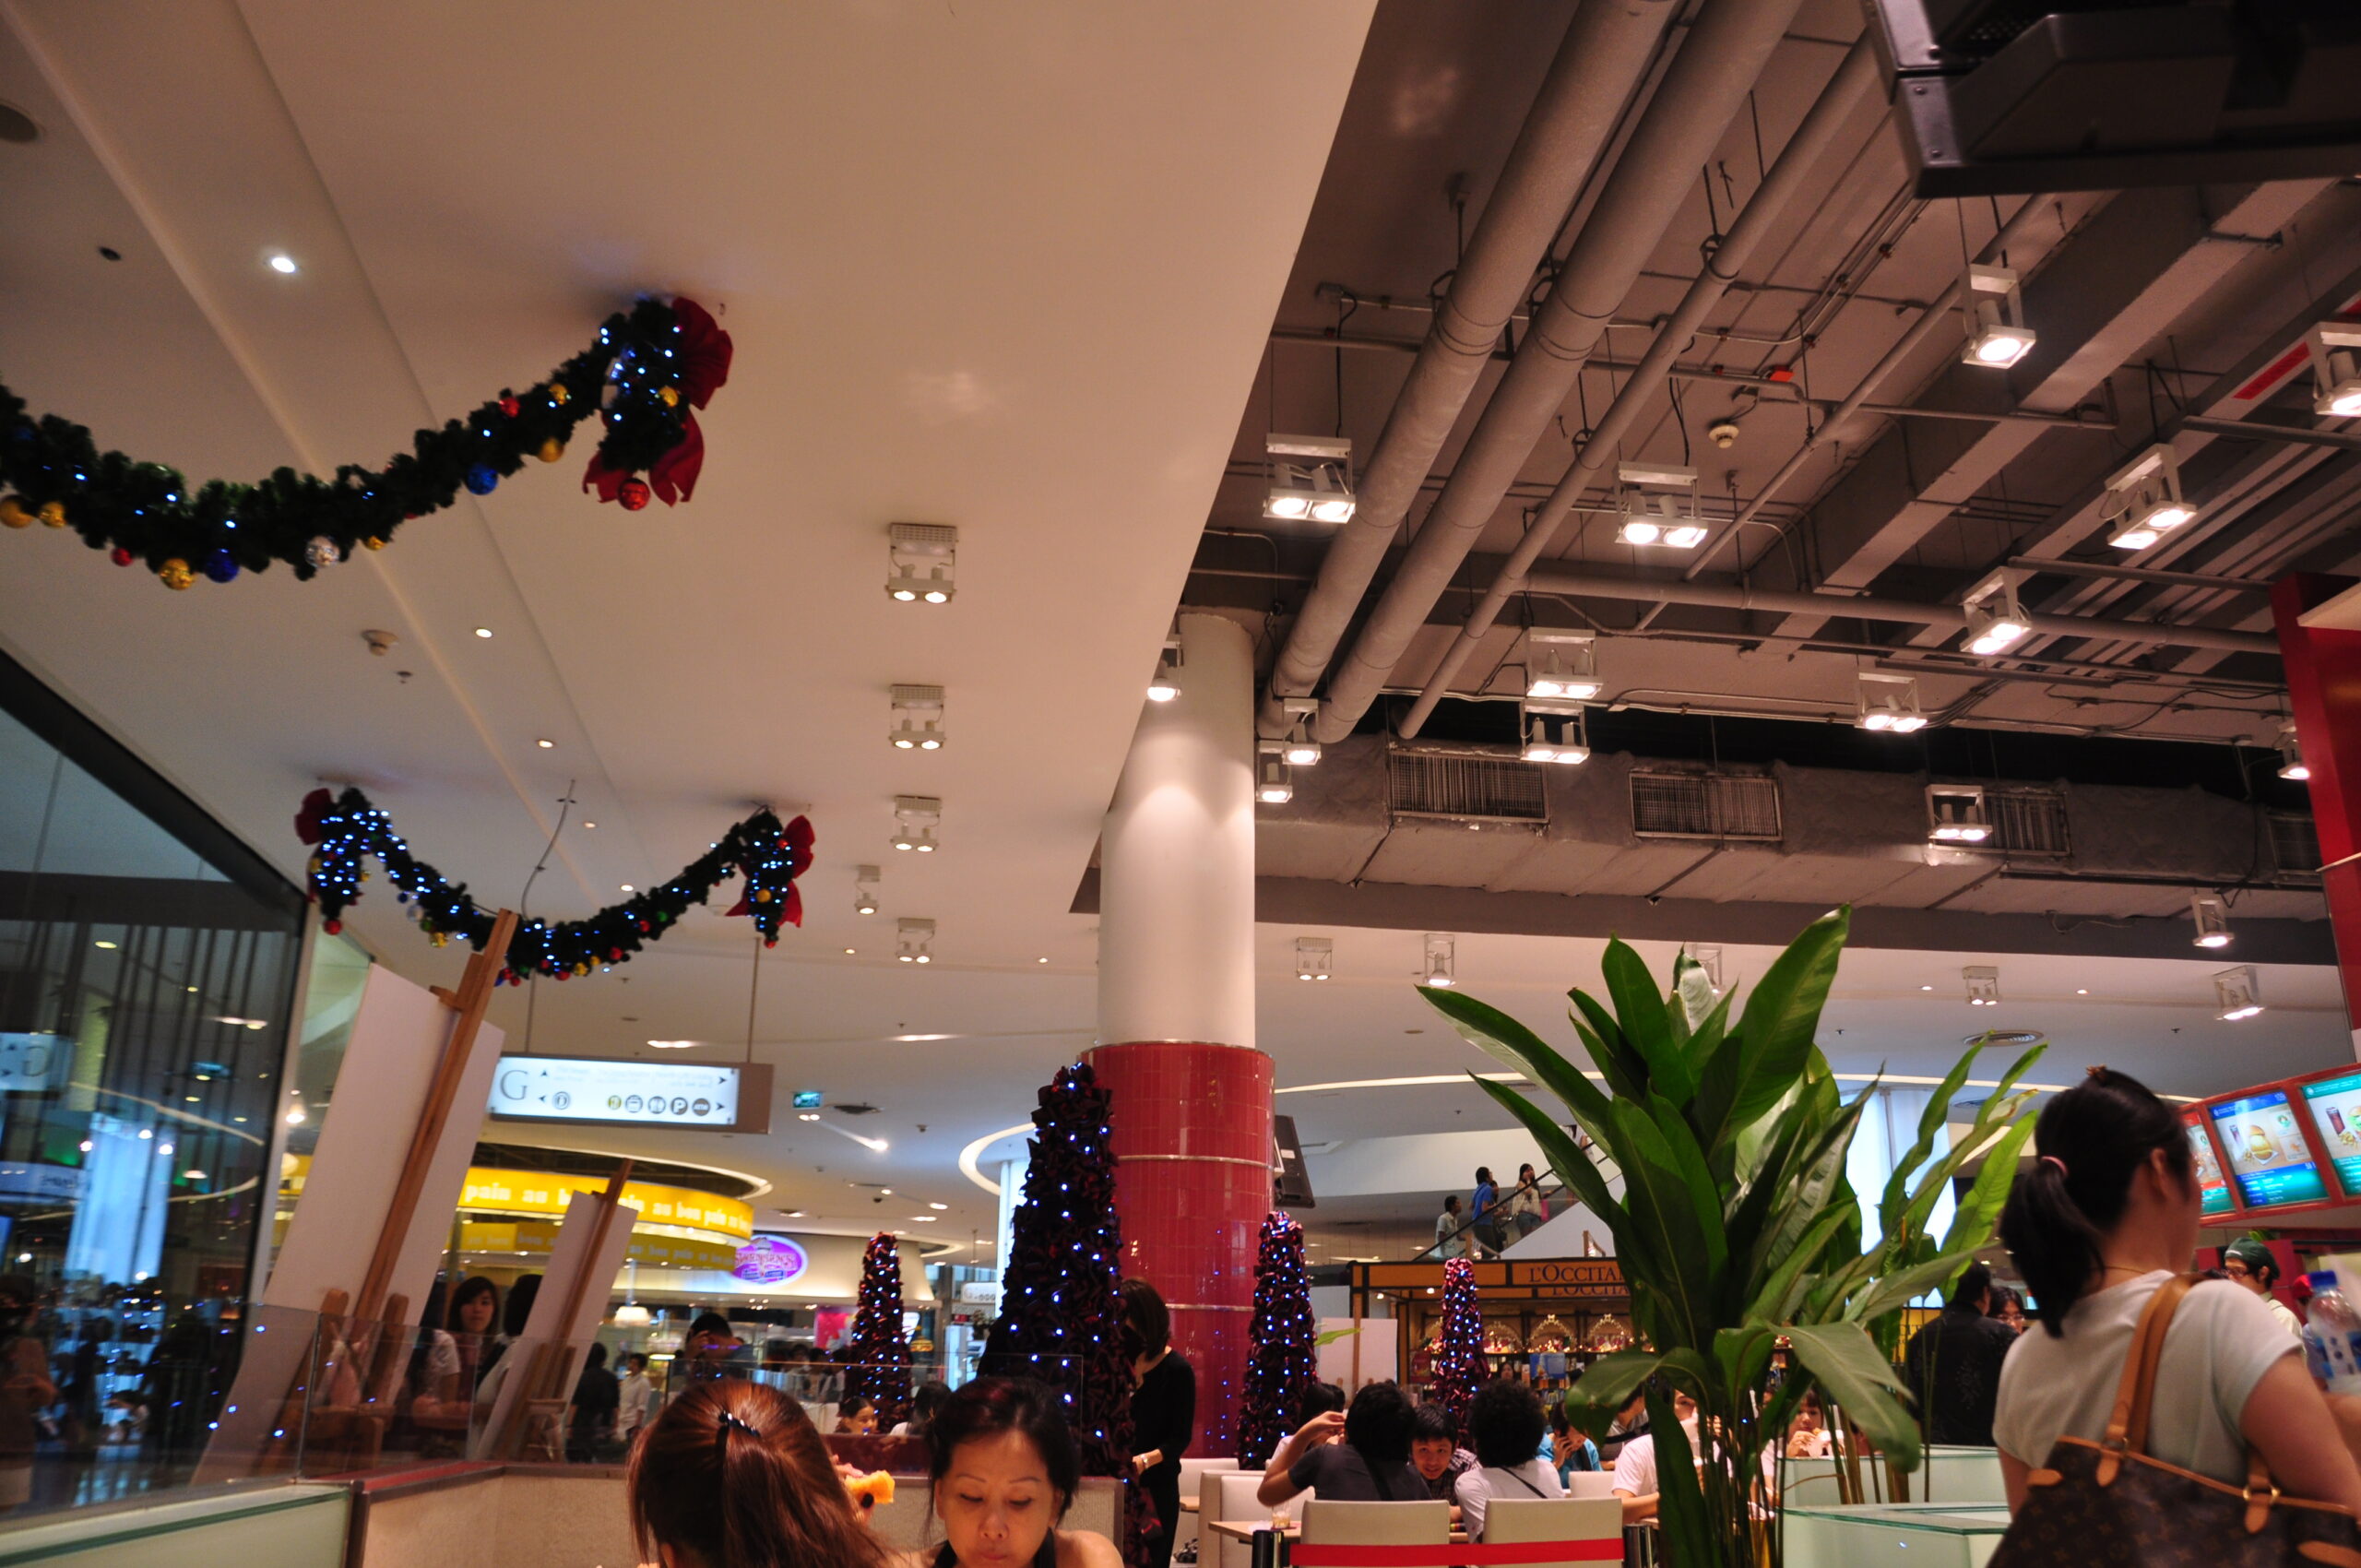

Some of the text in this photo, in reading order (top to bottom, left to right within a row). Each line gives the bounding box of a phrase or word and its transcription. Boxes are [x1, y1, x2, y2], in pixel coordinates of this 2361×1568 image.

[500, 1069, 528, 1100] G
[464, 1182, 512, 1203] pain
[522, 1189, 549, 1204] au
[652, 1202, 672, 1217] au
[676, 1201, 702, 1221] bon
